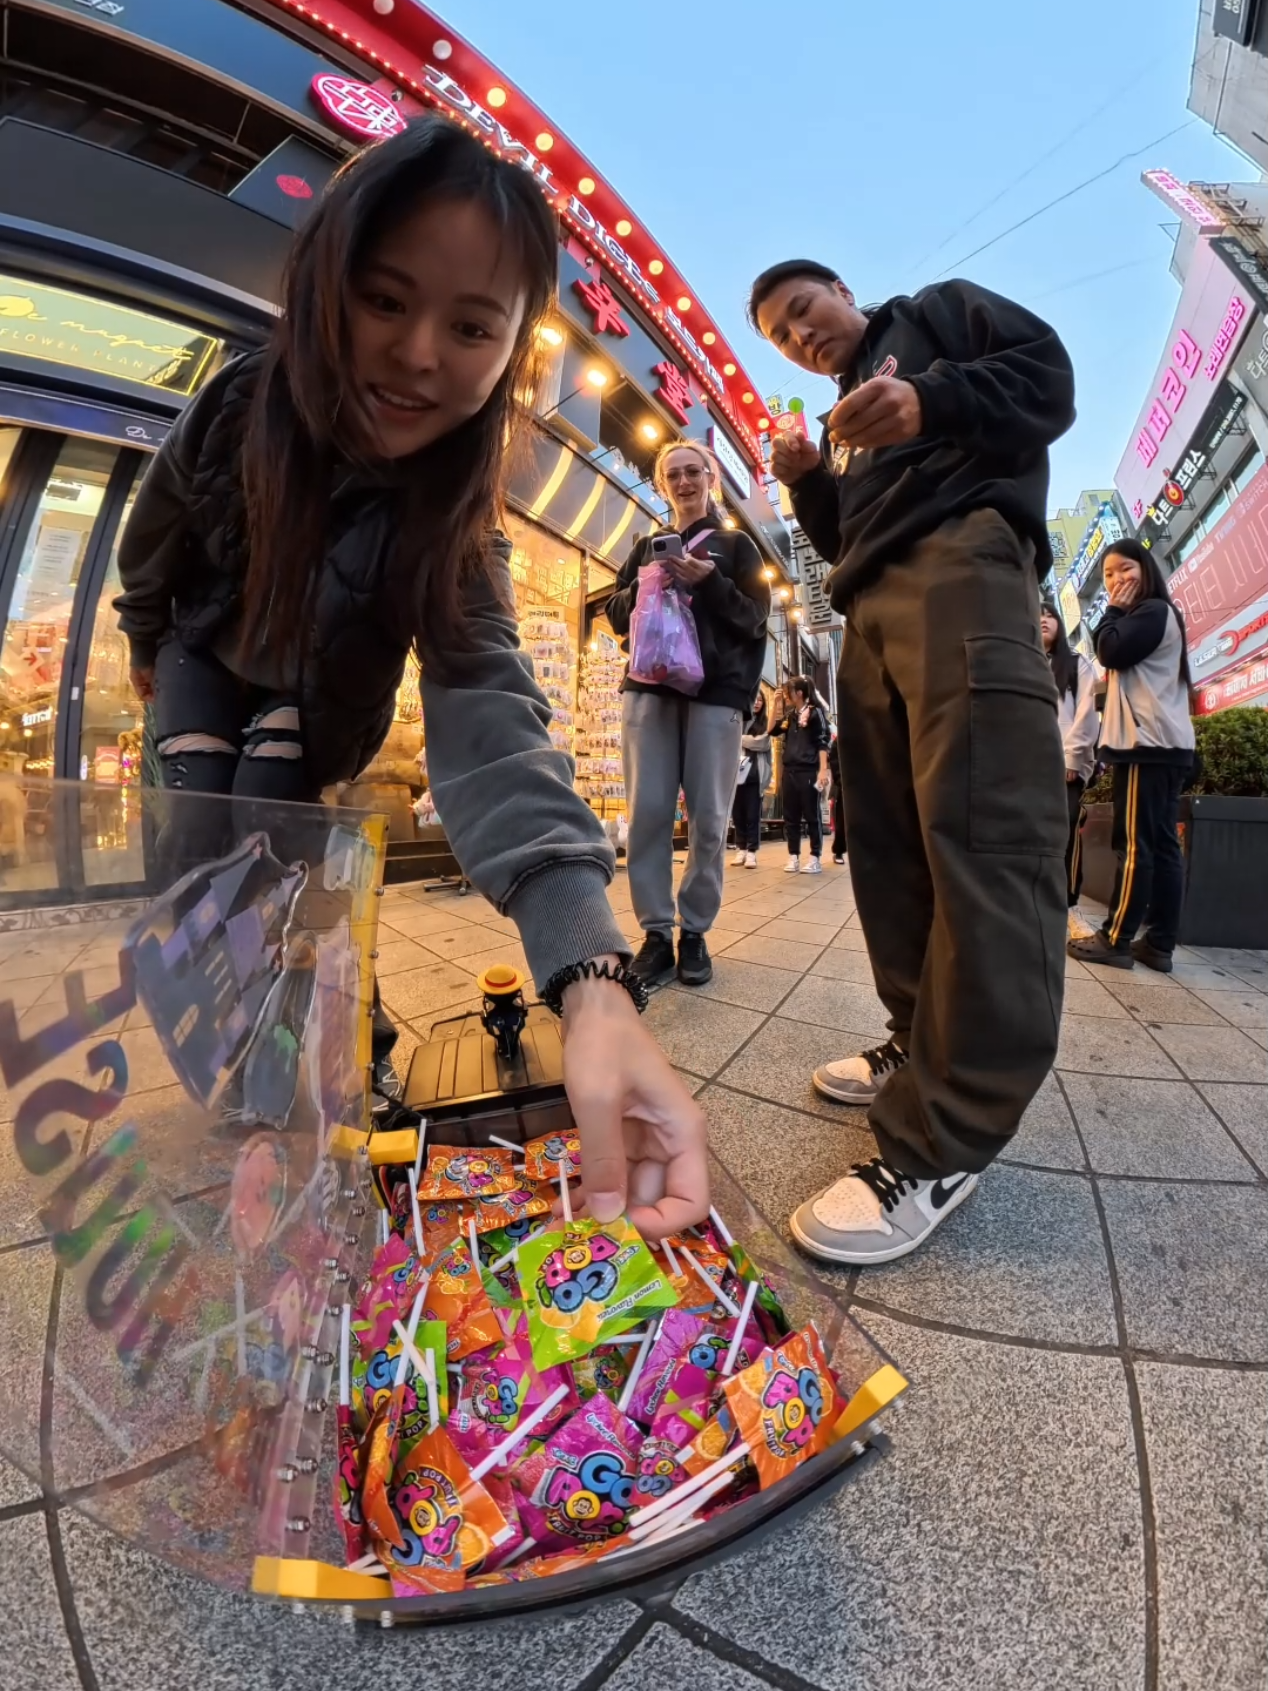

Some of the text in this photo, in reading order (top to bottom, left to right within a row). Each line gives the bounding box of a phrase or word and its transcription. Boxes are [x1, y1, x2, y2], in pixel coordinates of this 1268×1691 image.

[424, 64, 559, 196] DEVIL
[1203, 296, 1246, 381] 노래연습장
[1136, 329, 1202, 468] 페퍼코인
[1151, 503, 1174, 527] 다트
[1167, 569, 1188, 596] ETFLIX
[632, 1280, 662, 1302] Lemon
